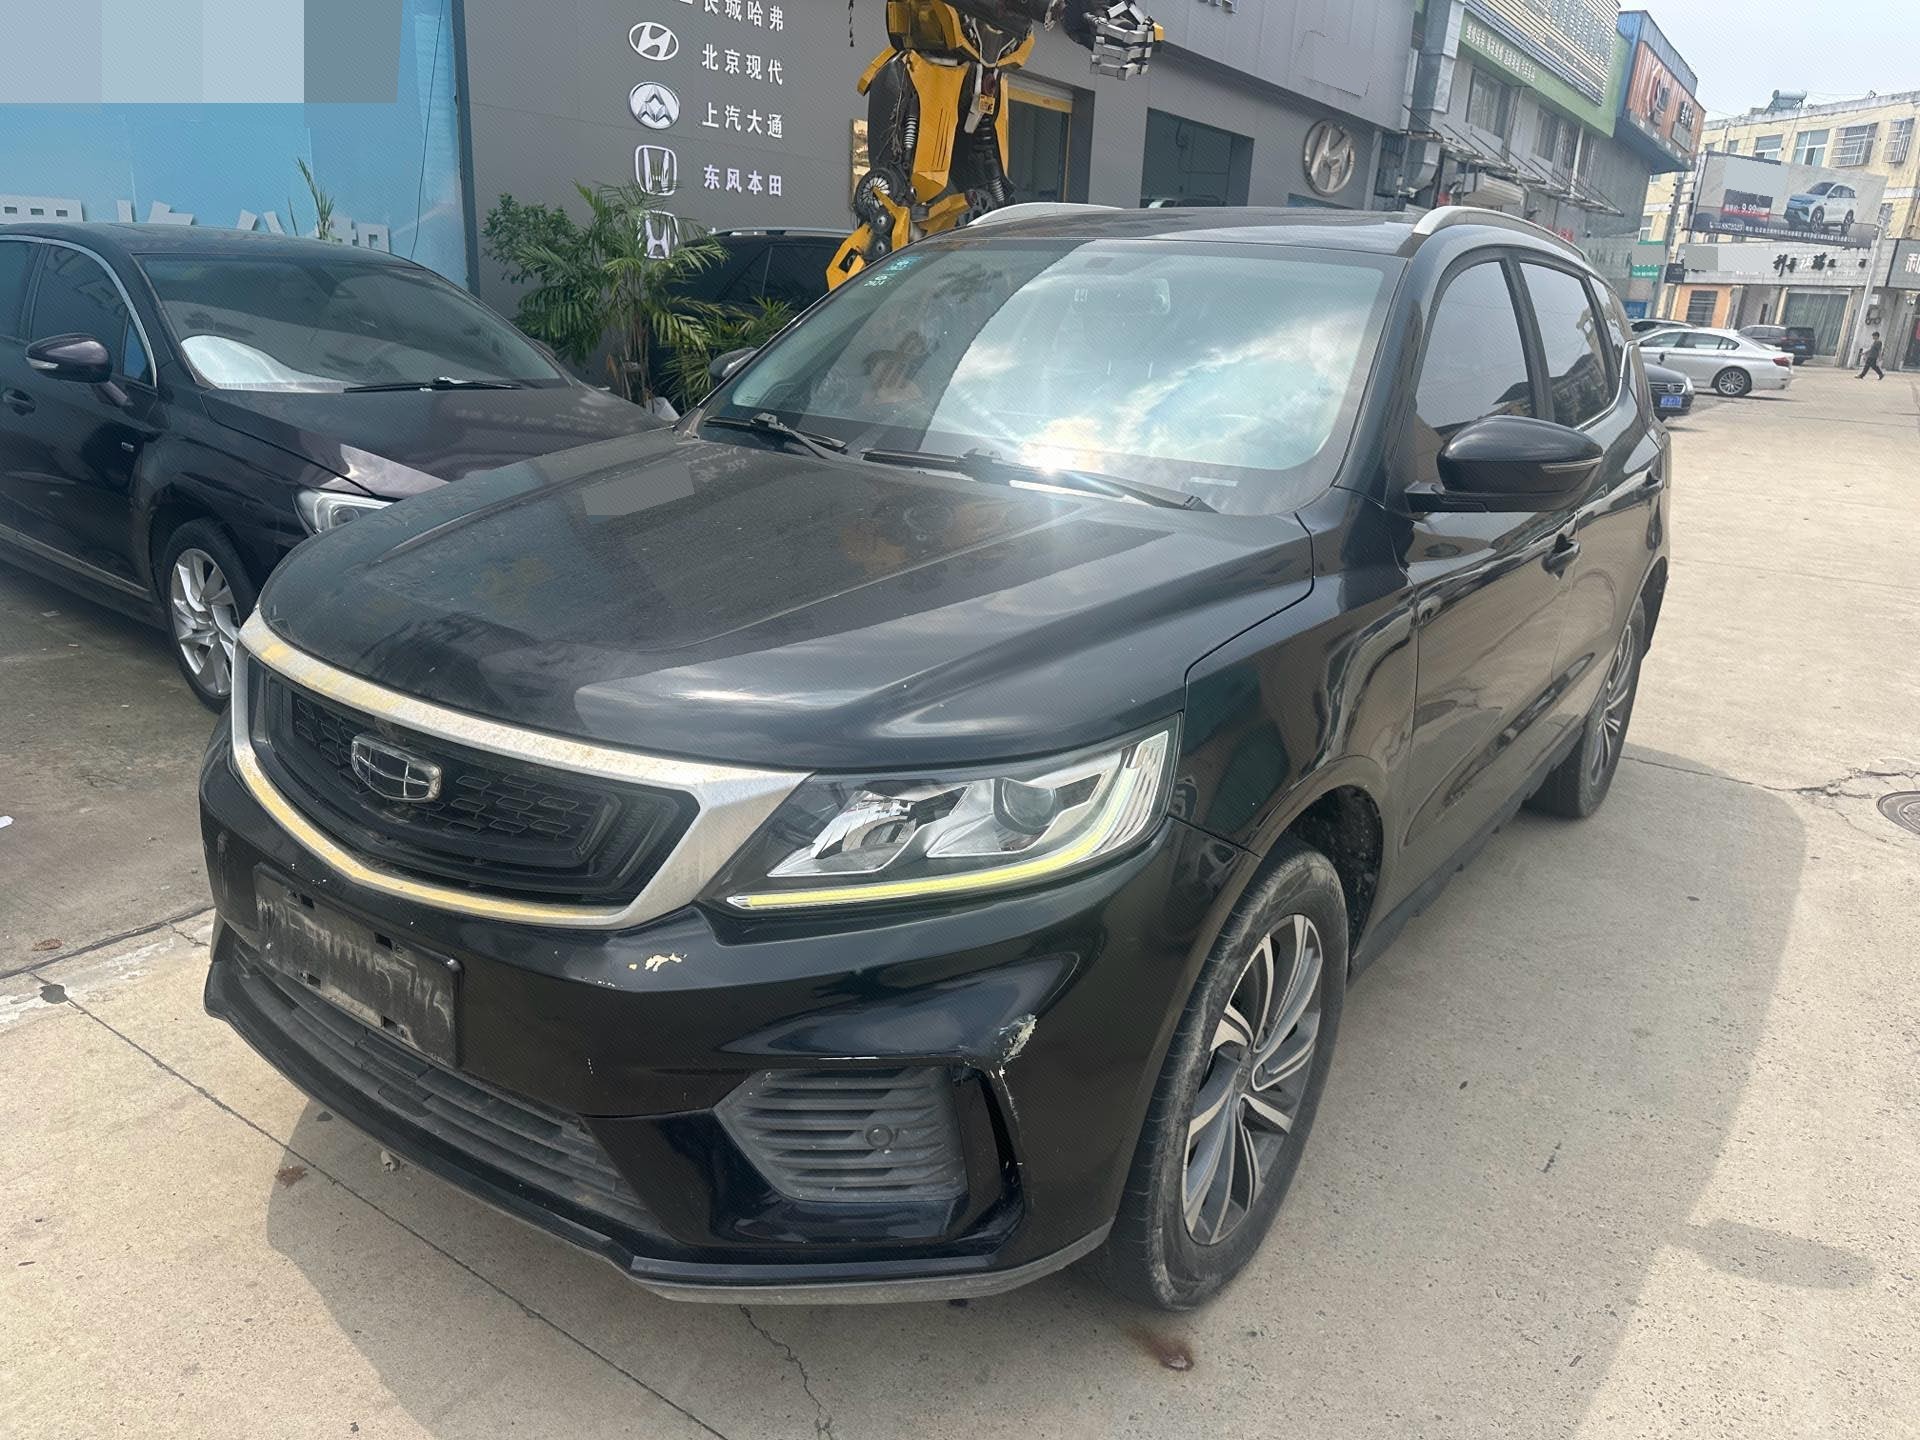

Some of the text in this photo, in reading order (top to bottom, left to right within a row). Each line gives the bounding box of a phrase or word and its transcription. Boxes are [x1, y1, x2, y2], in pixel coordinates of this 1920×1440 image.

[702, 44, 783, 85] 北京现代
[702, 102, 783, 139] 上汽大通
[703, 164, 782, 197] 东风本田
